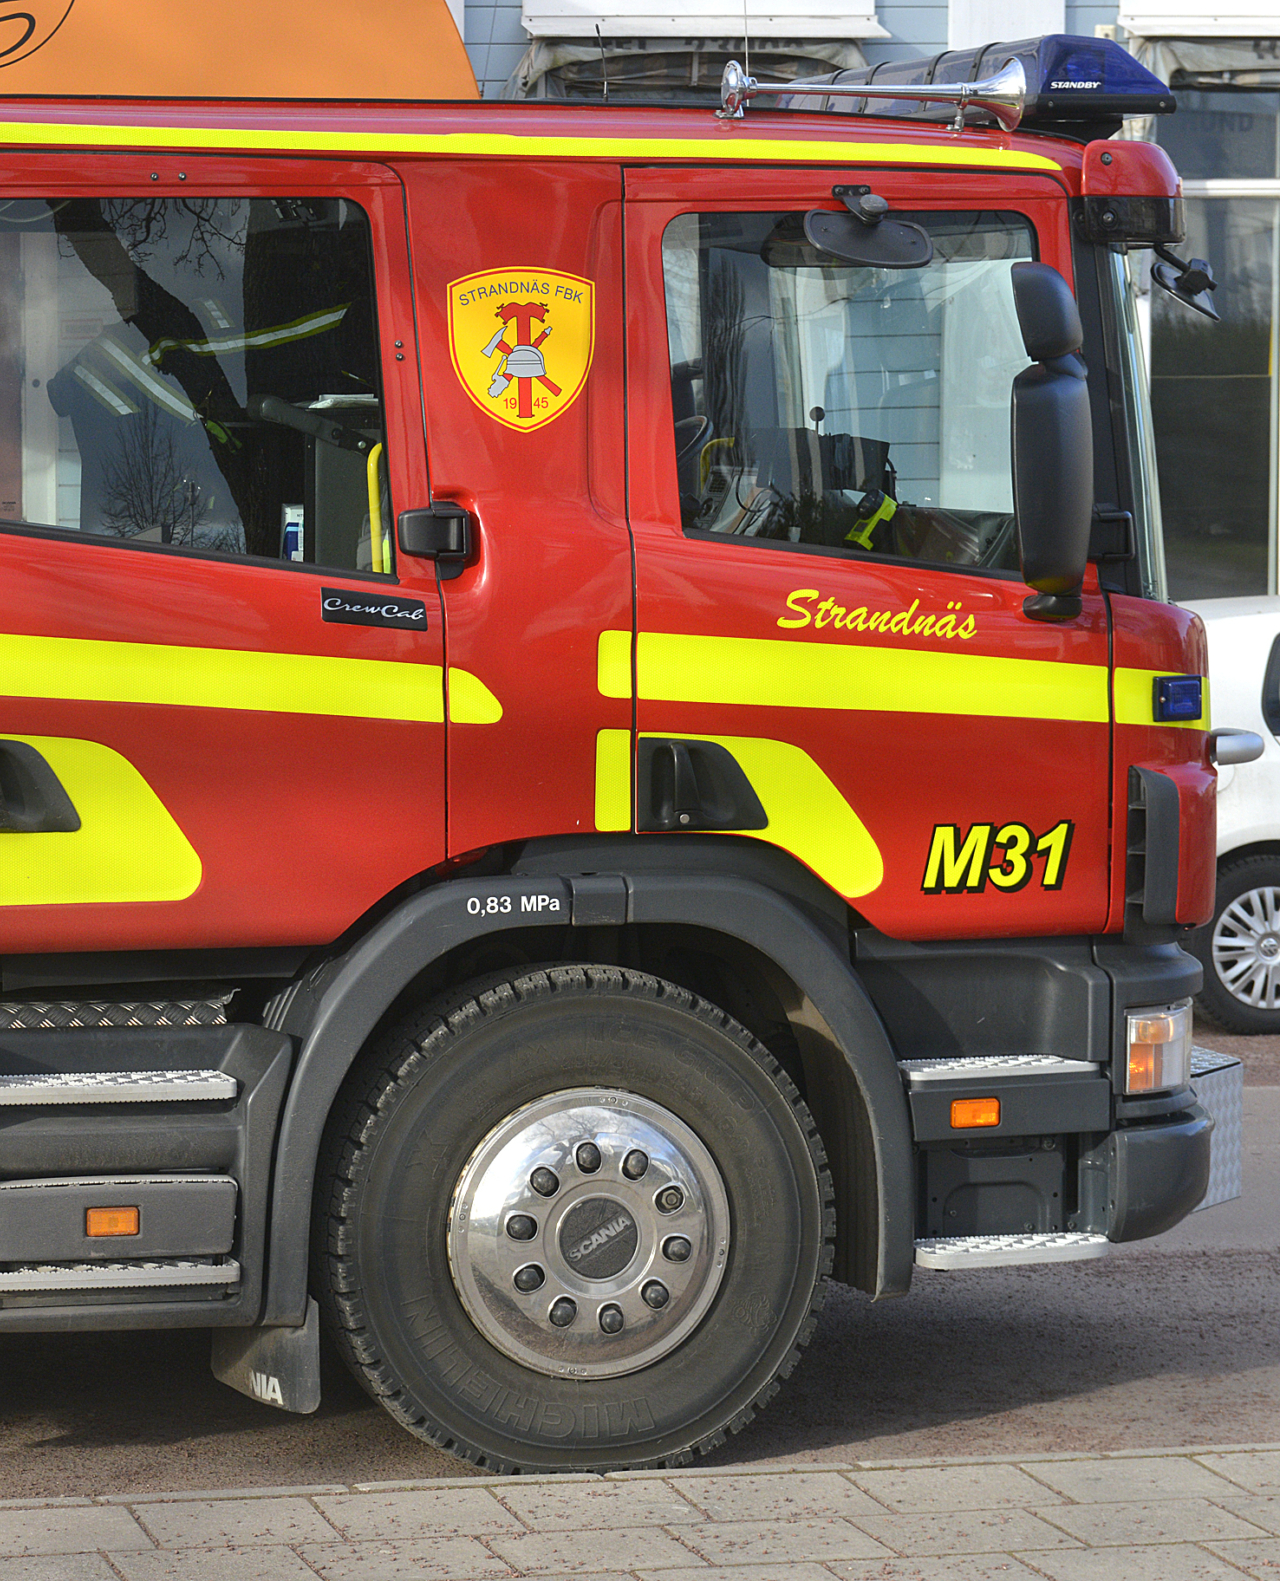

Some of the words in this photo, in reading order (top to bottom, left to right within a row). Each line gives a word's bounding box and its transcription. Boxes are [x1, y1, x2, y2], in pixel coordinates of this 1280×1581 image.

[1050, 81, 1102, 89] STANDBY
[459, 279, 550, 306] STRANDNÄS
[555, 285, 584, 304] FBK
[503, 397, 517, 410] 19
[533, 396, 549, 409] 45
[323, 597, 424, 620] CrewCab
[776, 588, 978, 640] Strandnäs
[920, 819, 1075, 895] M31
[466, 895, 512, 917] 0,83
[520, 894, 560, 912] MPa
[569, 1217, 632, 1262] SCANIA
[401, 1294, 656, 1439] MICHELIN
